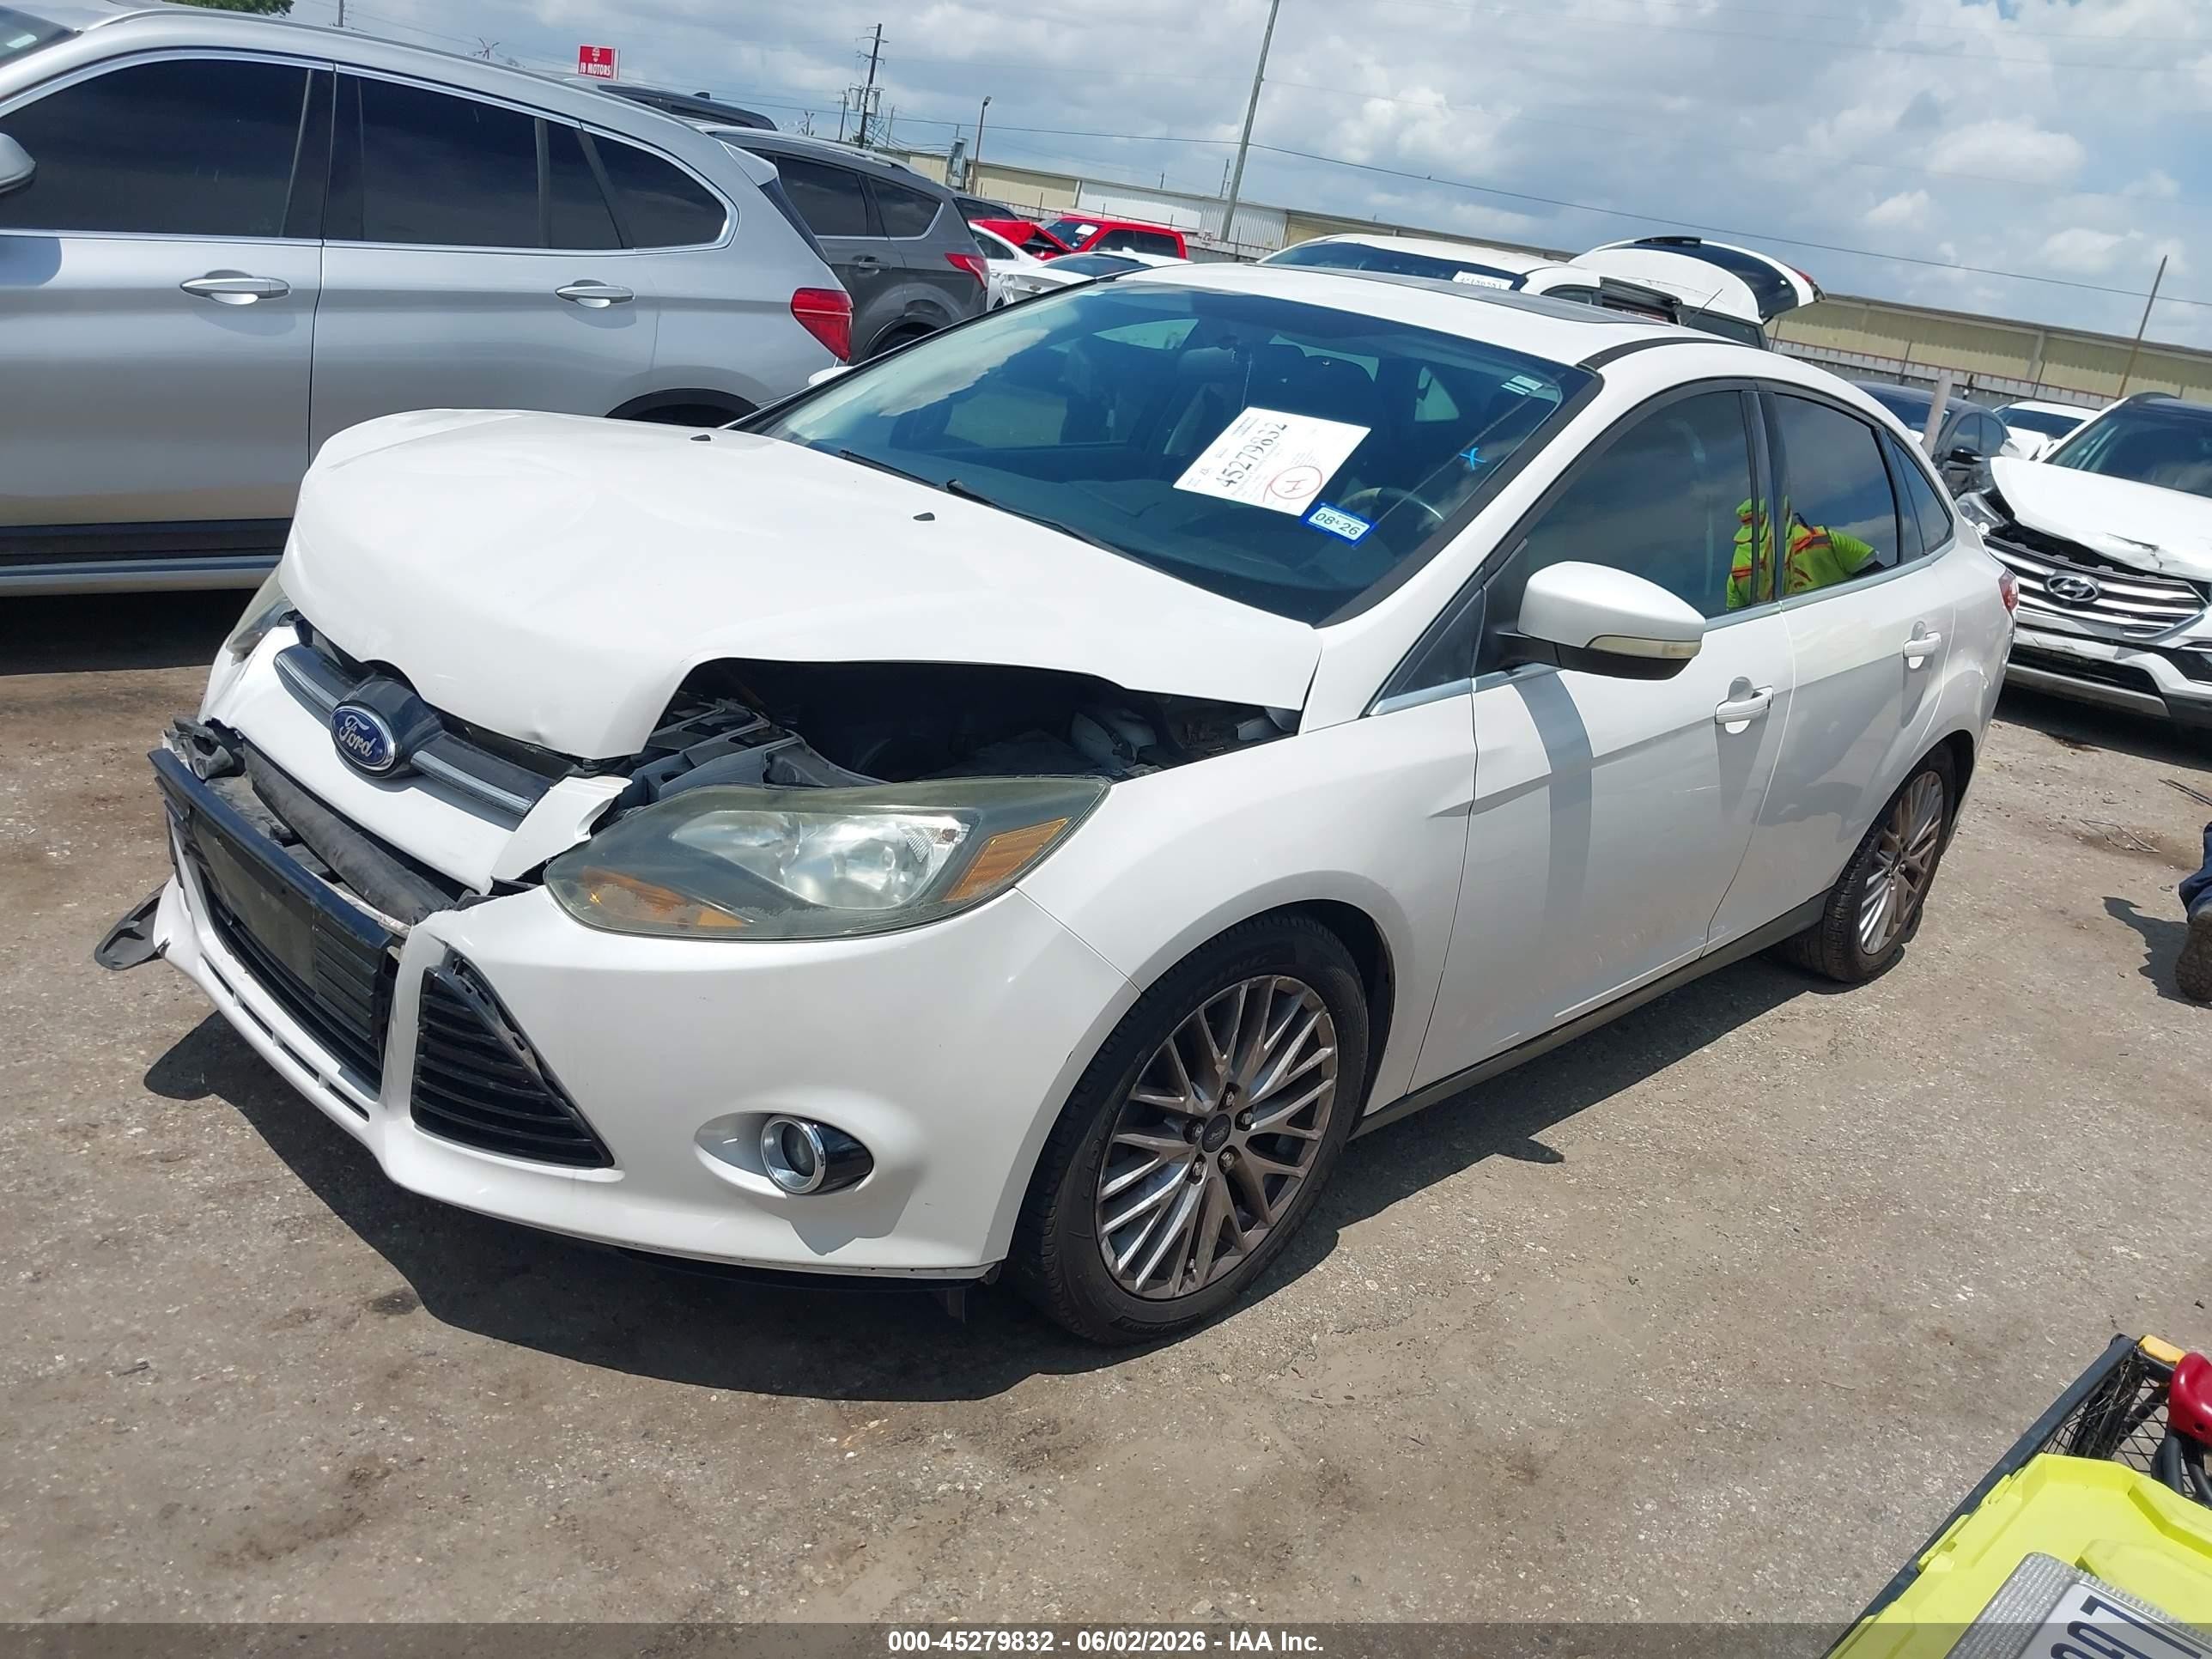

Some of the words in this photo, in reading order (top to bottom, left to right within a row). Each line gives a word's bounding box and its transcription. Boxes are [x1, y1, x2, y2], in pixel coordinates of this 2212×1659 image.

[587, 63, 611, 76] MOTORS
[1216, 422, 1288, 488] 45279832
[338, 714, 377, 757] Ford
